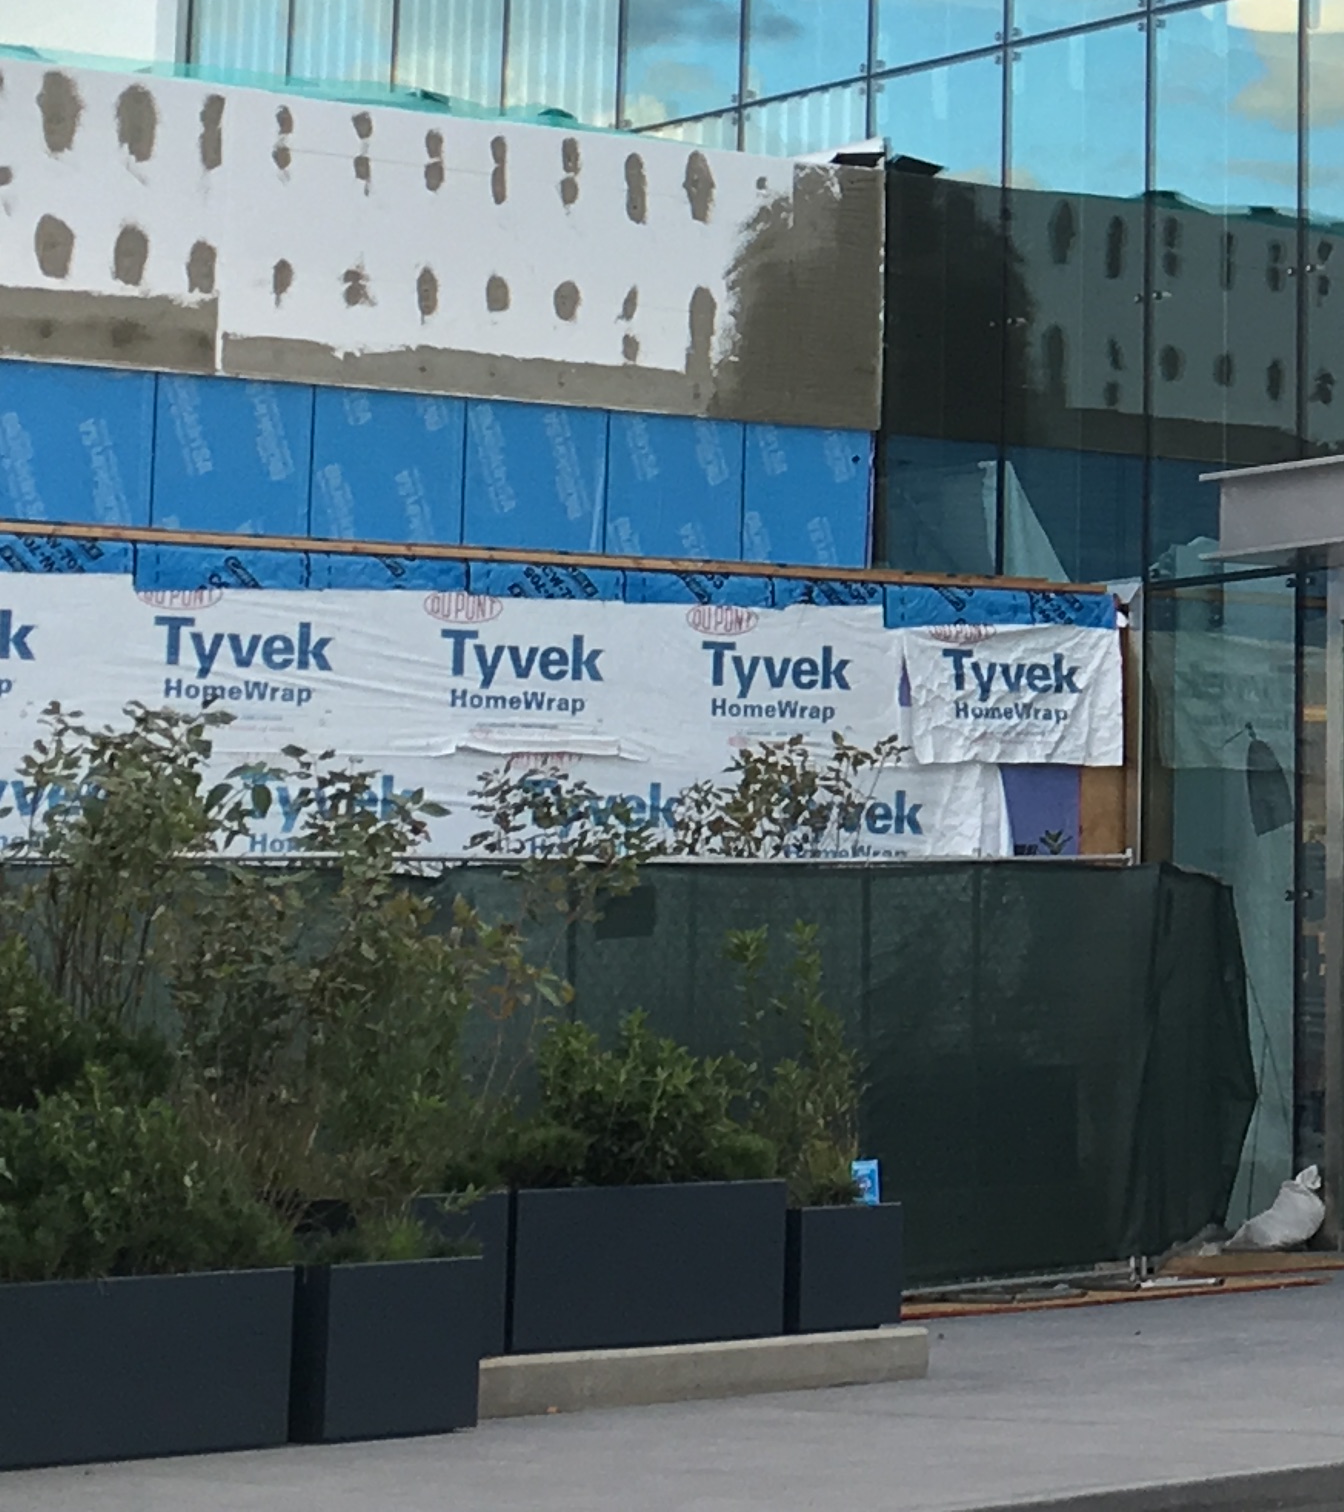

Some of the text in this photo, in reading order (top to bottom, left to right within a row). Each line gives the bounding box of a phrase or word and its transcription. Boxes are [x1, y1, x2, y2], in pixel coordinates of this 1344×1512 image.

[155, 616, 335, 678] Tyvek
[441, 628, 605, 689] Tyvek
[702, 641, 852, 699] Tyvek
[164, 678, 313, 707] HomeWrap
[942, 648, 1083, 702] Tyvek
[450, 689, 586, 716] HomeWrap
[711, 698, 836, 723] HomeWrap
[955, 701, 1068, 724] HomeWrap
[523, 778, 682, 837] Tvek
